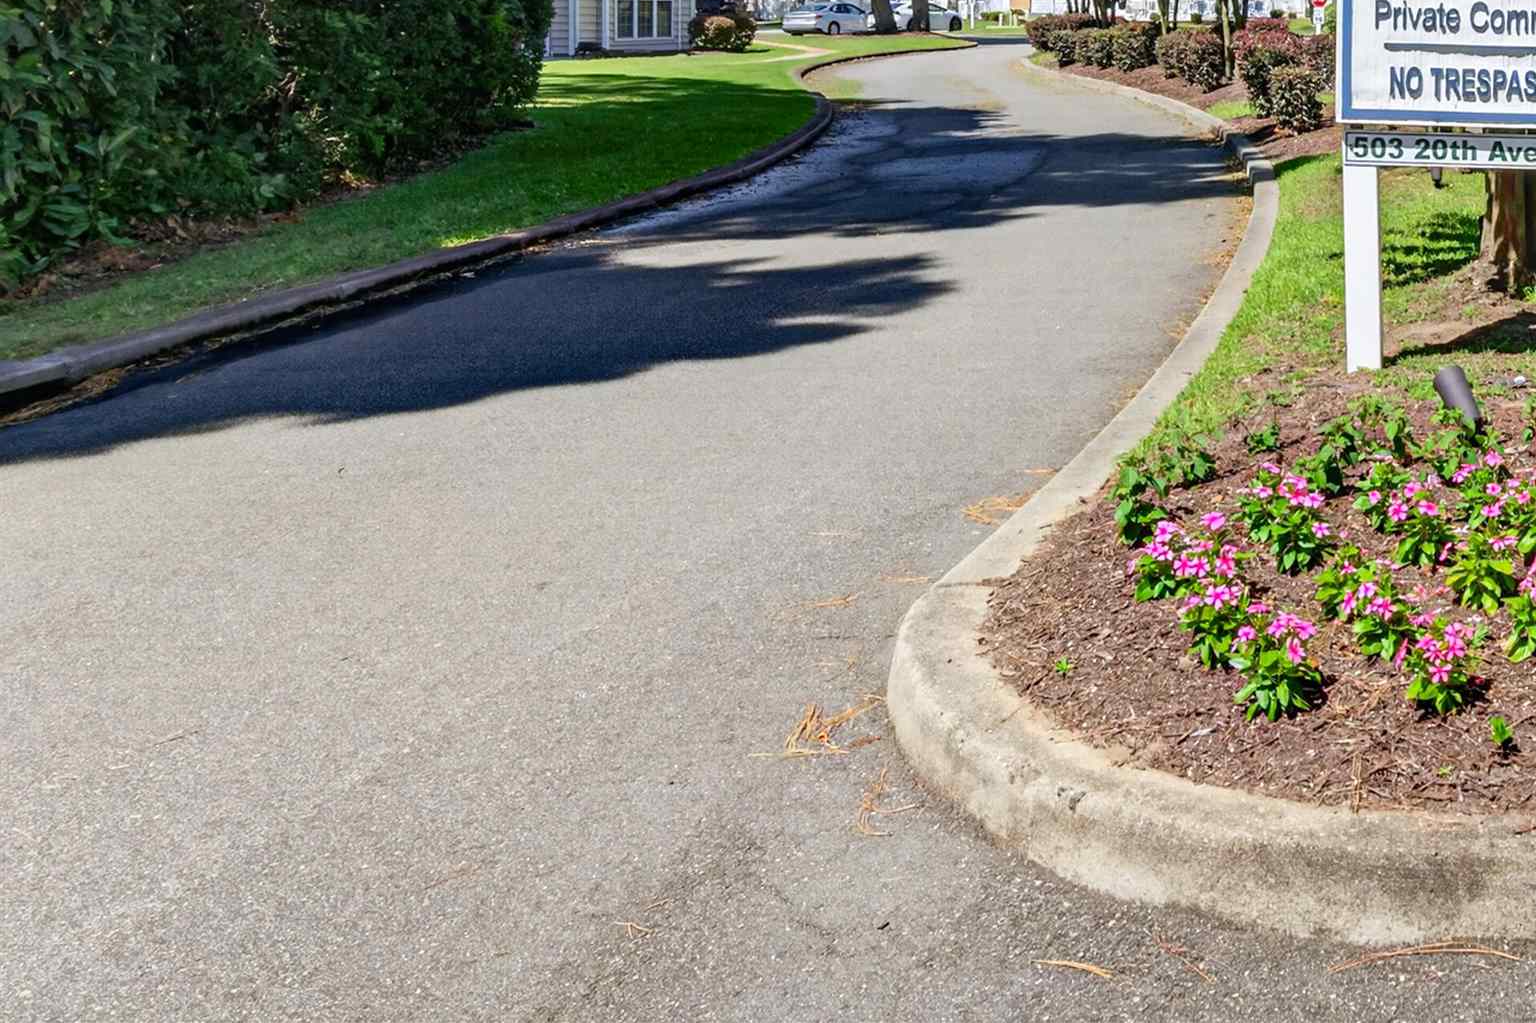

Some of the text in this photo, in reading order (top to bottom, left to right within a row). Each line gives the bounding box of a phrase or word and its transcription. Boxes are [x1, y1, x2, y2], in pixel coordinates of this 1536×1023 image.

[1374, 0, 1461, 34] Private
[1389, 66, 1424, 101] NO
[1353, 136, 1403, 160] 503
[1414, 138, 1477, 161] 20th
